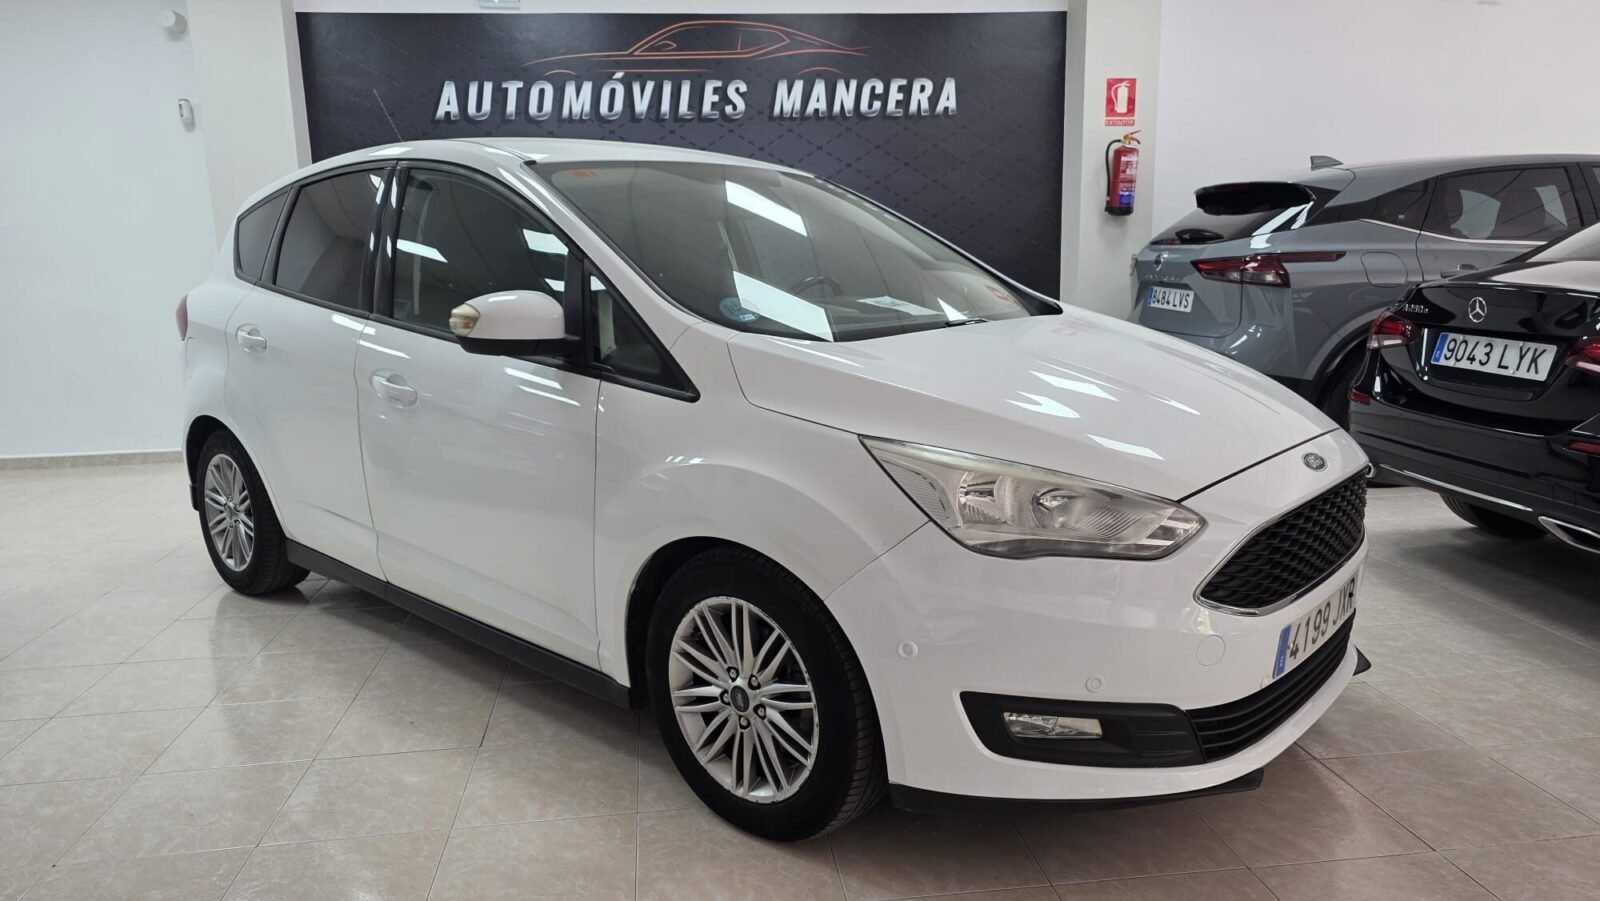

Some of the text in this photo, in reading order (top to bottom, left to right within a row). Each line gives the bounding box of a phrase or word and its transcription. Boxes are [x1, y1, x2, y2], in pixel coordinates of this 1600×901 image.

[434, 71, 958, 121] AUTOMÓVILES MANCERA
[1152, 289, 1190, 309] 8484 LVS
[1444, 338, 1548, 375] 9043 LYK
[1289, 578, 1355, 660] 4199 JXR
